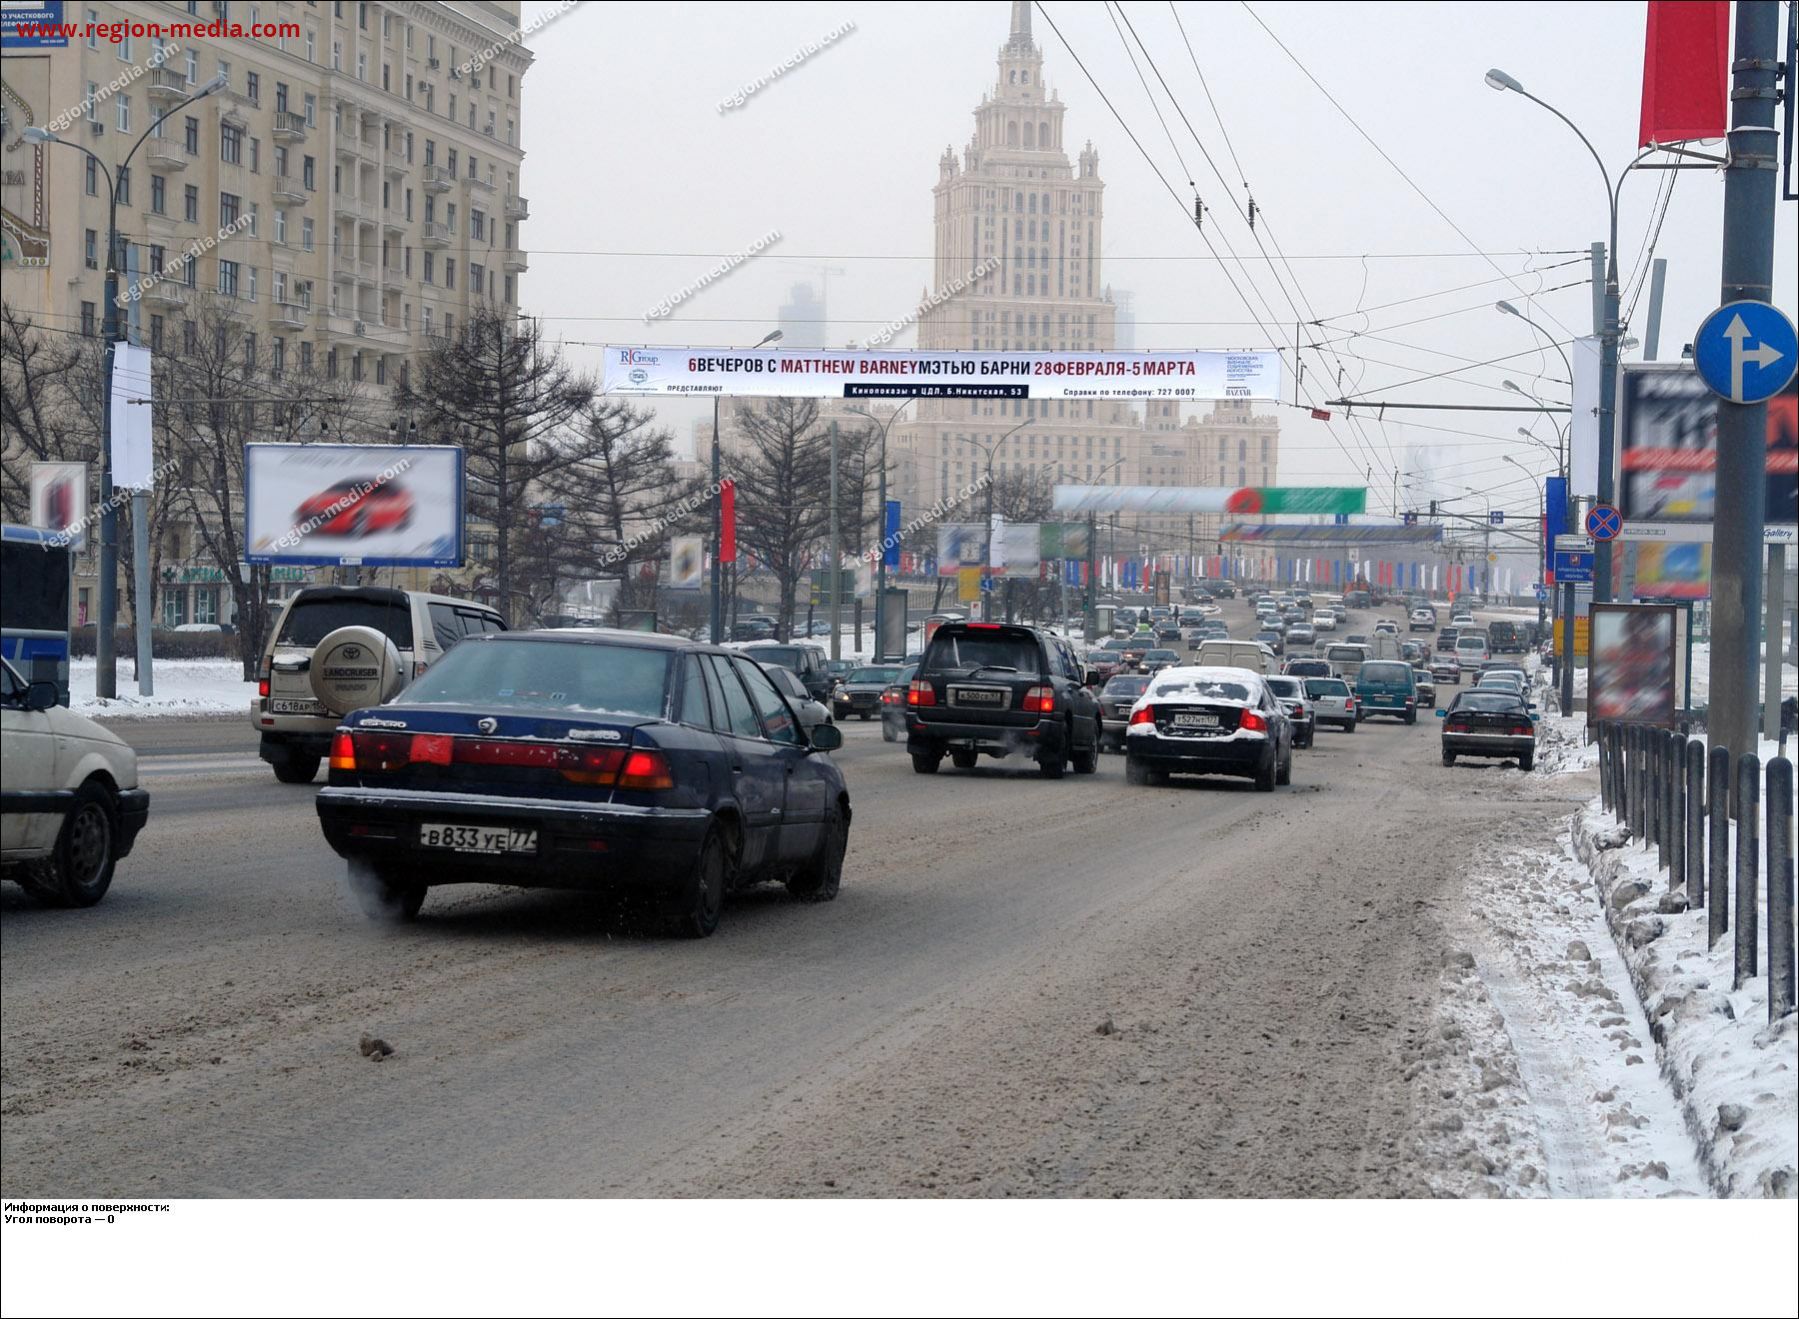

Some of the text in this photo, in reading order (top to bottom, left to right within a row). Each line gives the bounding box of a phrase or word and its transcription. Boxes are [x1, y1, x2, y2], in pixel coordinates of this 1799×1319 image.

[768, 360, 777, 373] С
[781, 359, 855, 374] MATTHEW
[981, 361, 1030, 375] БАРНИ
[667, 384, 723, 392] ПРЕДСТАВЛЯЮТ
[852, 386, 908, 395] Кинопоказы
[1011, 388, 1022, 396] 53
[1063, 388, 1096, 397] Справки
[1112, 388, 1155, 398] телефону:
[1157, 388, 1172, 396] 727
[1175, 388, 1196, 396] 0007
[1763, 529, 1793, 540] Gallery
